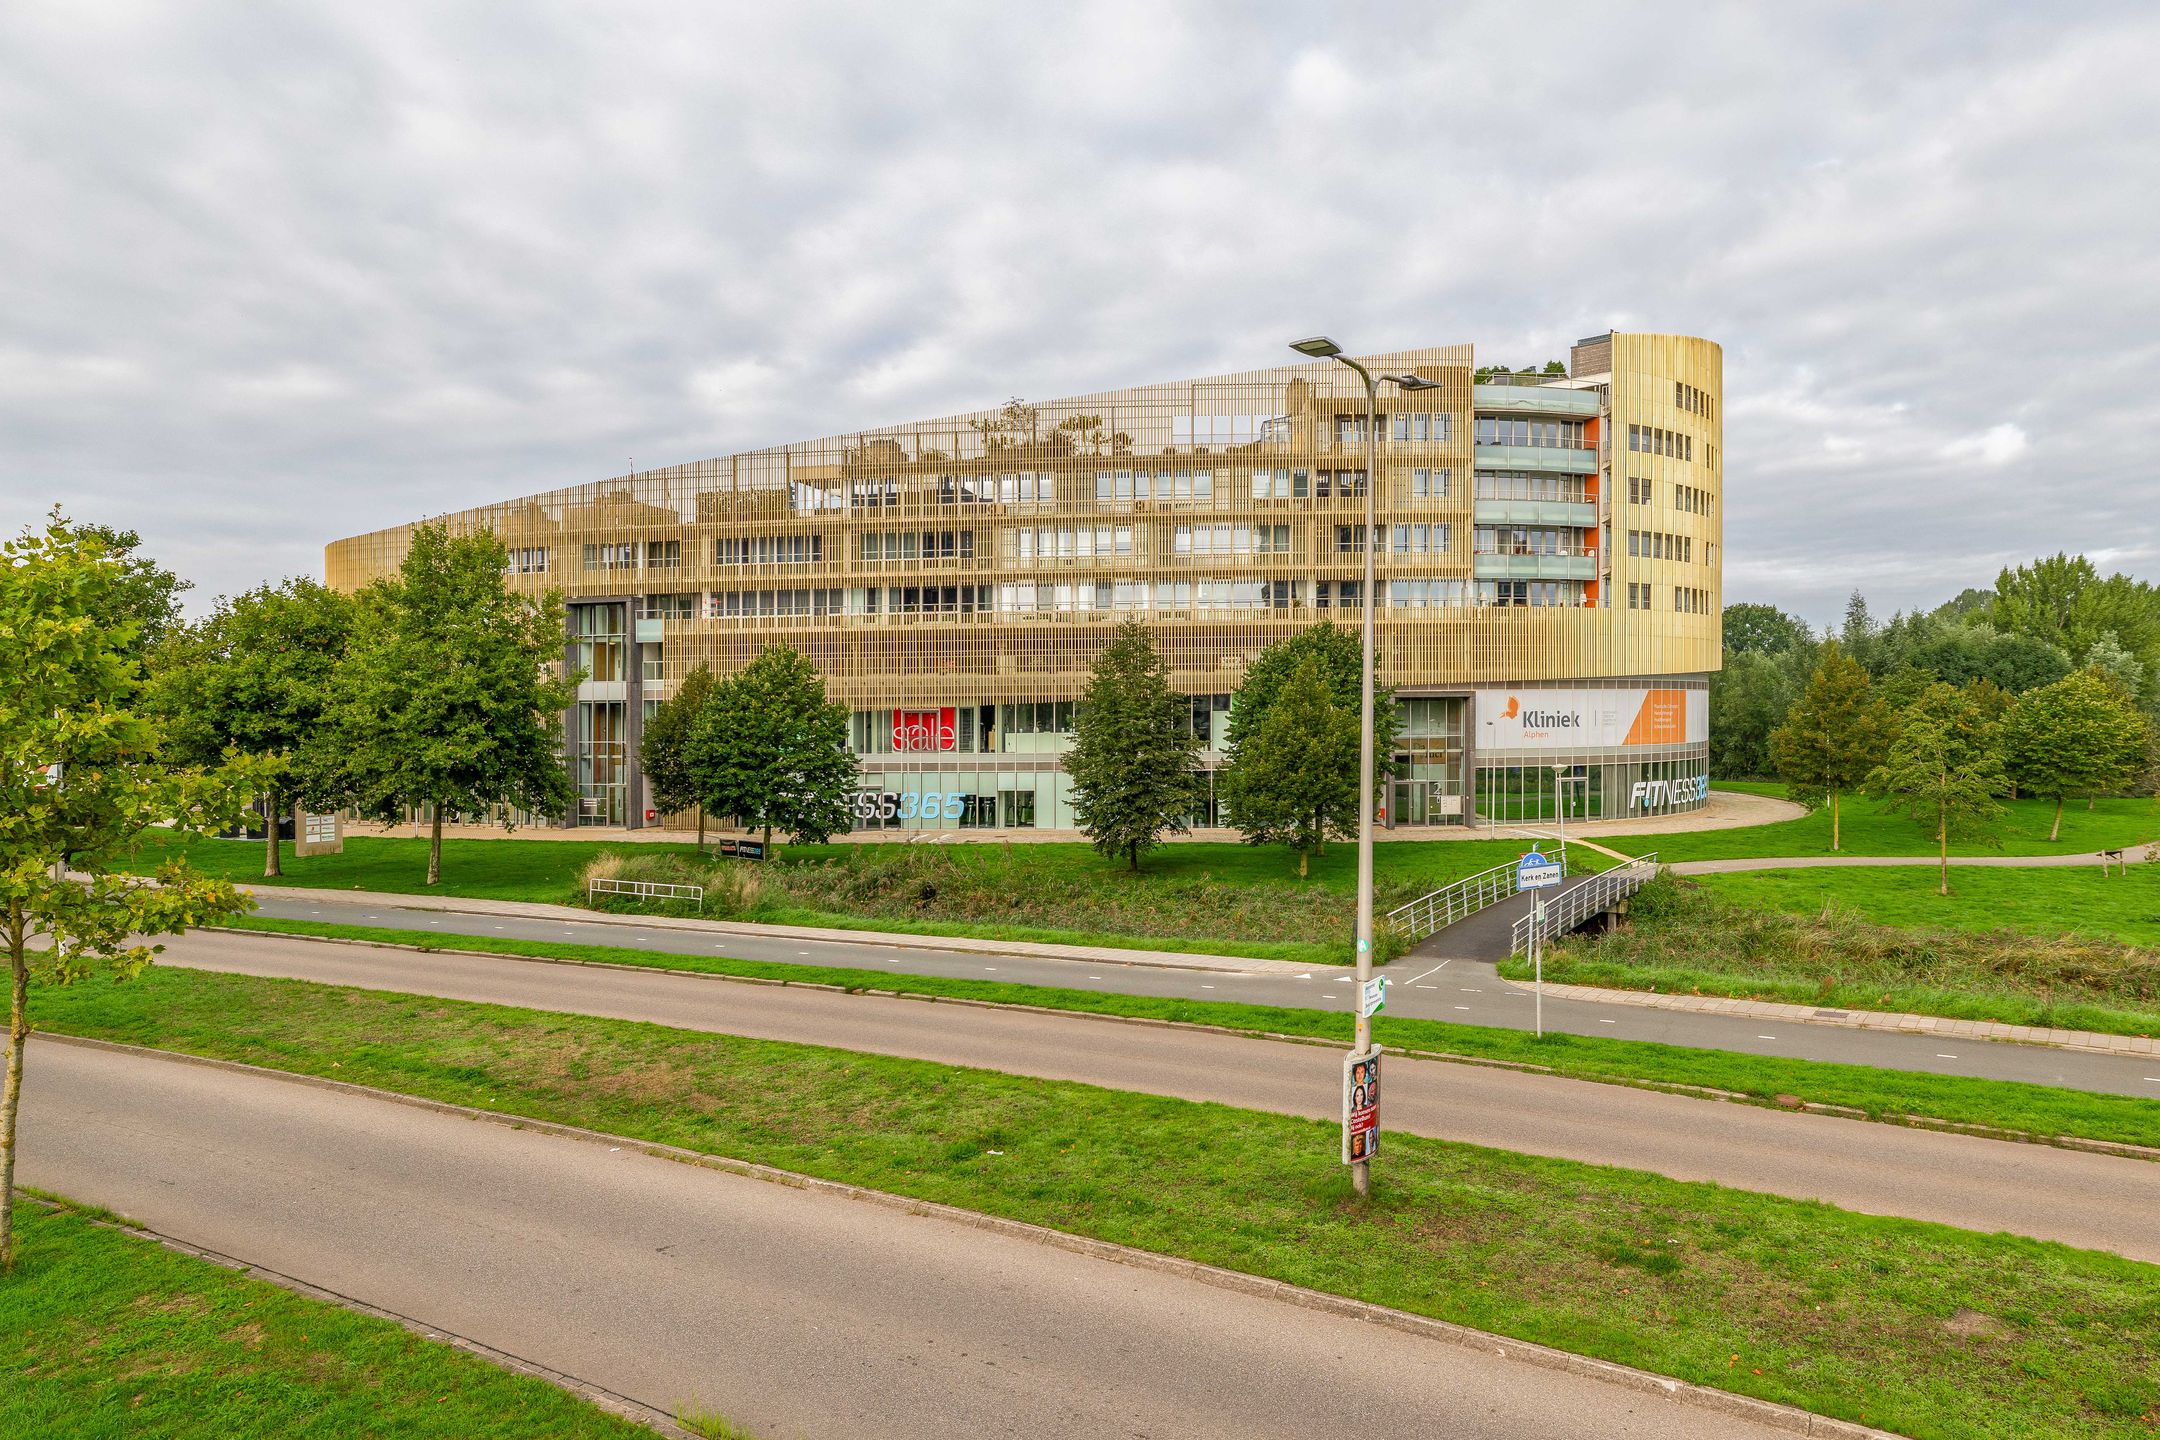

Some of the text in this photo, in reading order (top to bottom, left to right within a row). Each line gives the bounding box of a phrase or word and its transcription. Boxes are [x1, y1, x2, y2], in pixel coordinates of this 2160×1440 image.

[1522, 710, 1580, 728] Kliniek
[892, 717, 955, 751] sale
[1523, 731, 1549, 739] Alphen
[1521, 874, 1534, 882] Kerk
